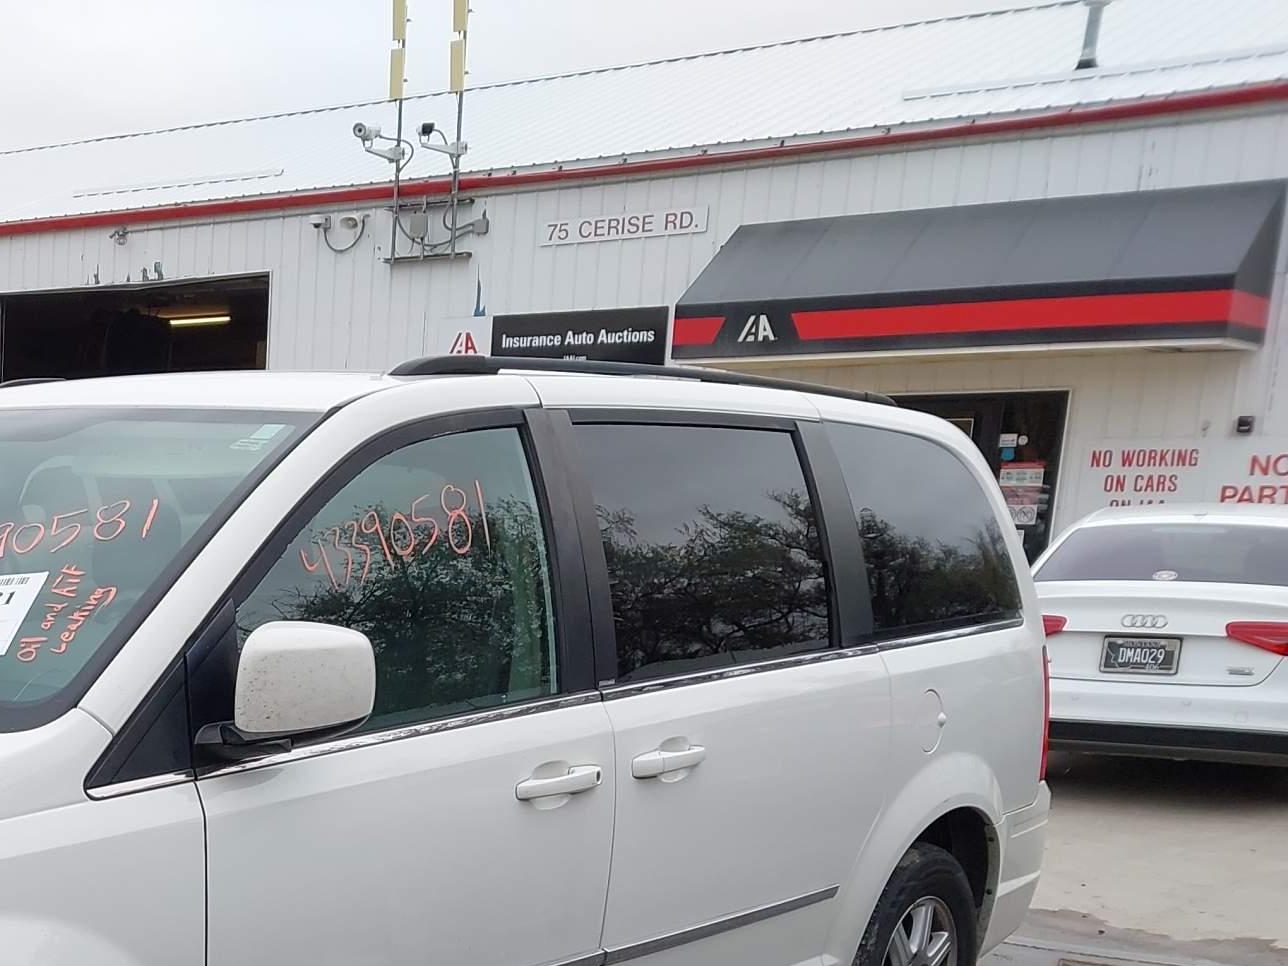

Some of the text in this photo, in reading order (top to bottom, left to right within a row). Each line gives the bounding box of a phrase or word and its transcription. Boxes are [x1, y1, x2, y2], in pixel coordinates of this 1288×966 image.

[547, 211, 699, 241] 75 CERISE RD.
[501, 328, 656, 349] Insurance Auto Auctions
[1090, 448, 1200, 468] NO WORKING
[1103, 474, 1179, 492] ON CARS
[300, 479, 492, 590] 43390581
[40, 602, 69, 631] and
[1117, 647, 1166, 665] DMA029
